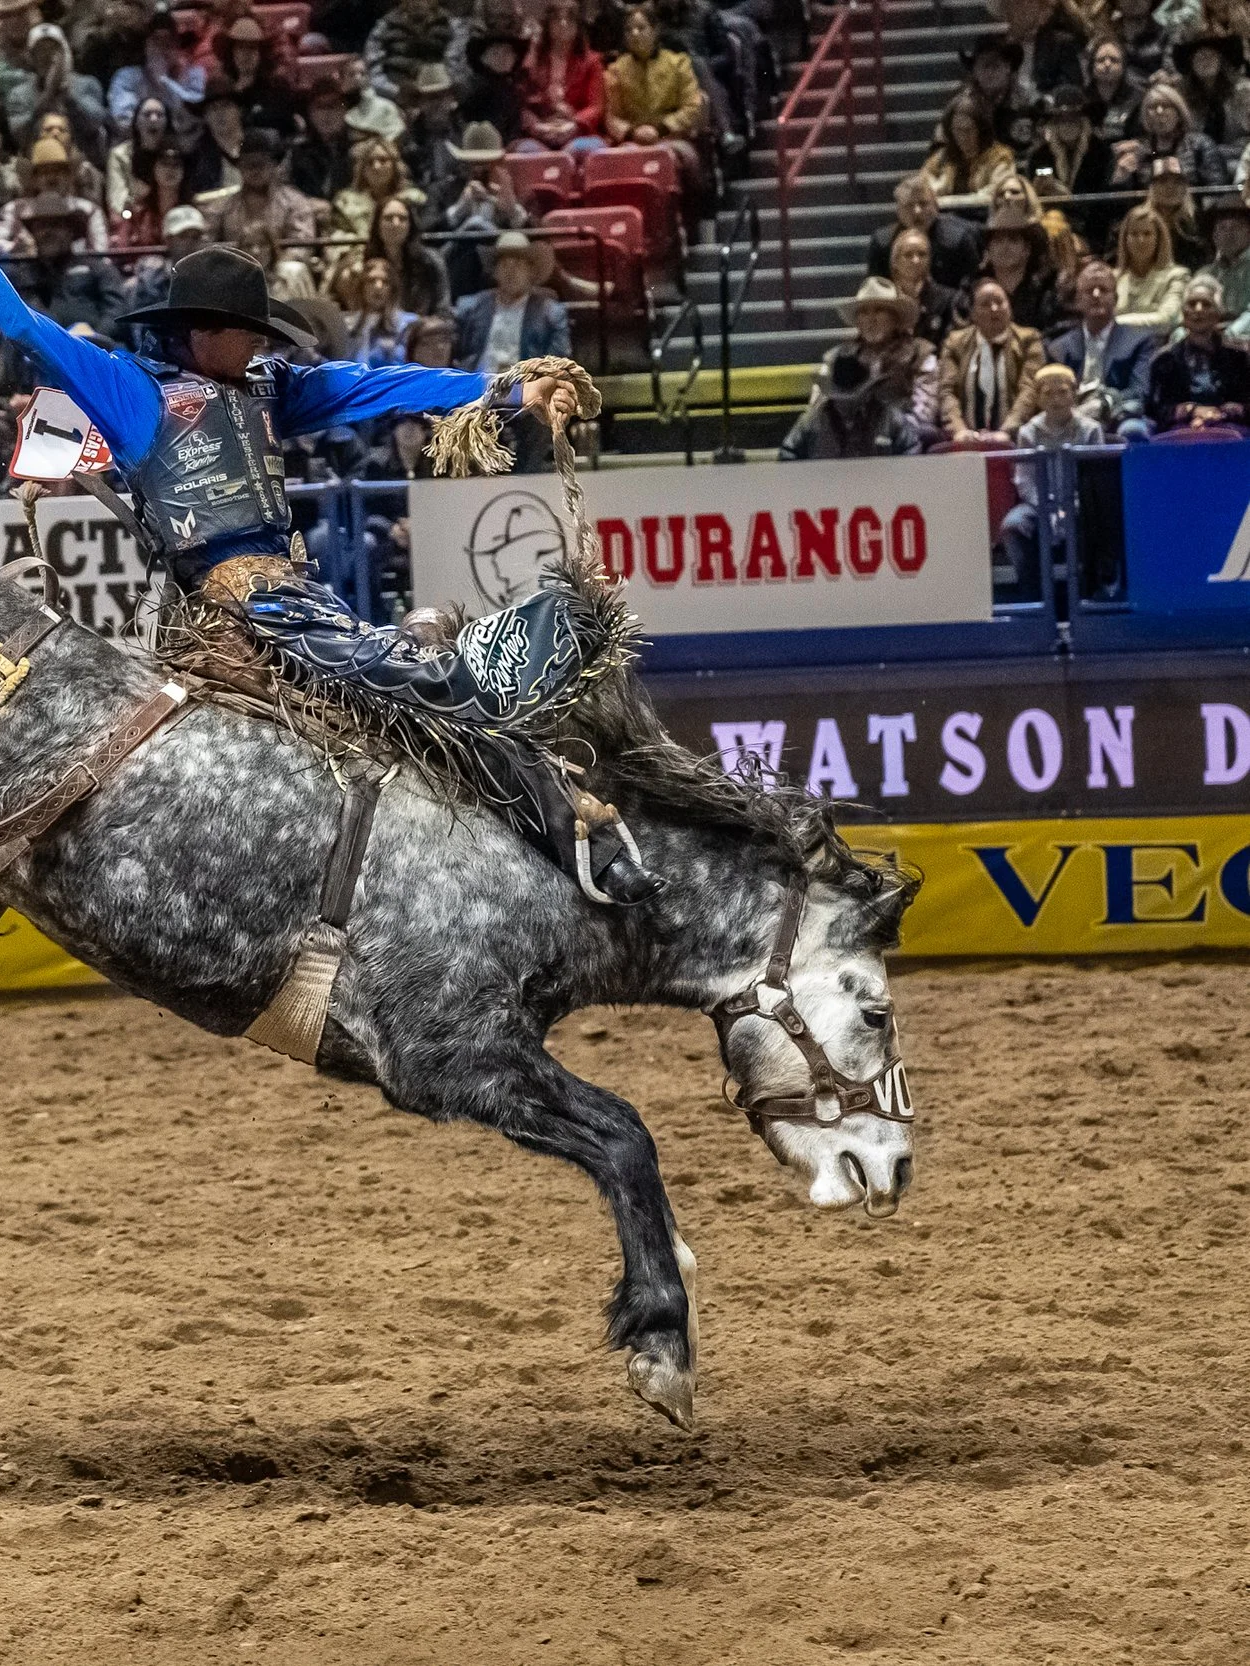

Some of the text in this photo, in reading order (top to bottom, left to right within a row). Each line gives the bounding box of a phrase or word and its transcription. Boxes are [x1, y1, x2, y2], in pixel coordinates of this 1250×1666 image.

[33, 417, 84, 445] 1
[226, 389, 246, 429] WRIGHT
[238, 432, 261, 480] WESTERN
[174, 473, 228, 494] POLARIS
[596, 503, 927, 588] DURANGO
[711, 706, 1136, 797] WATSON
